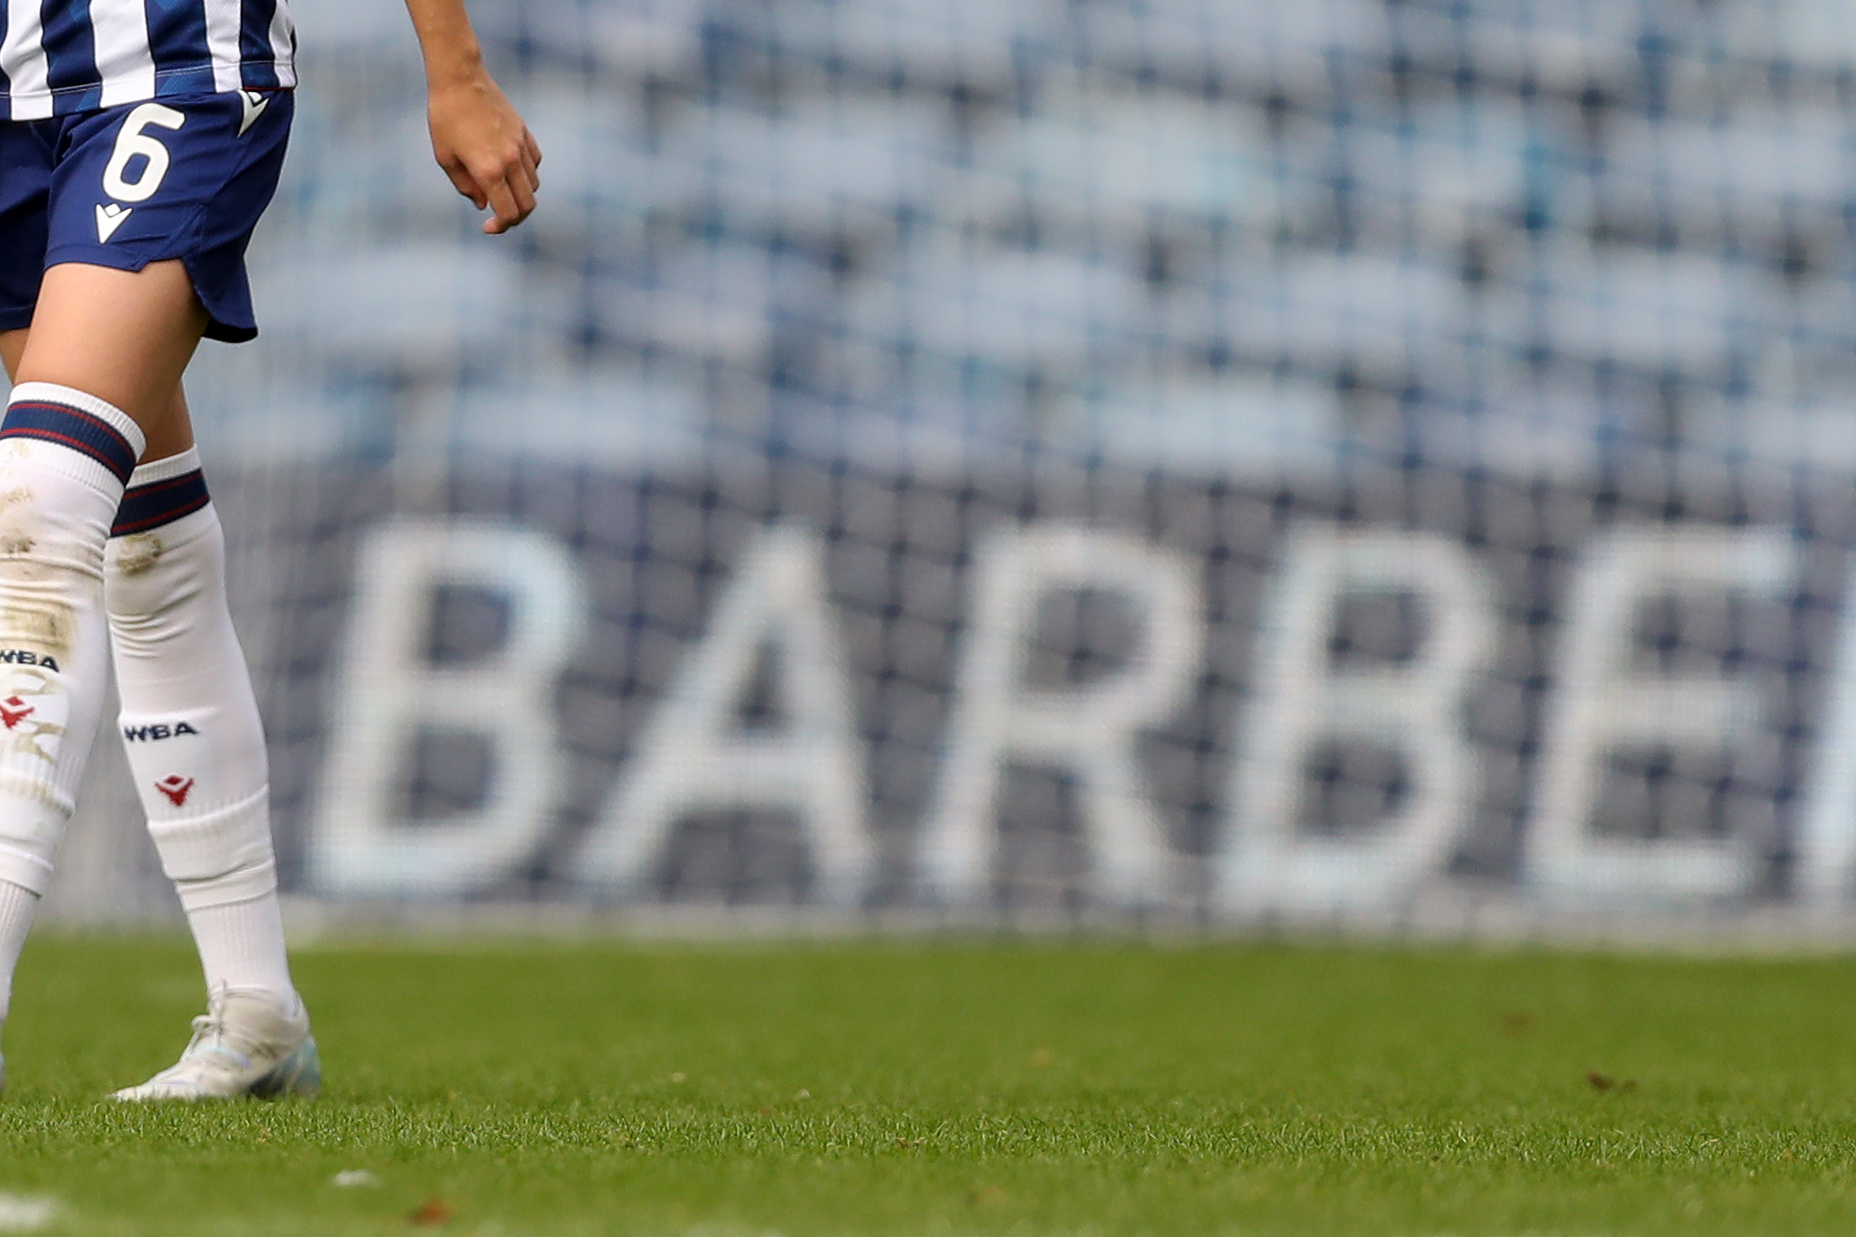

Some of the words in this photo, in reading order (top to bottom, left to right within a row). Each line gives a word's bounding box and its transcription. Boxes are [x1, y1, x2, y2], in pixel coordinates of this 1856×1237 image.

[102, 102, 186, 202] 6
[124, 720, 199, 743] WBA
[312, 517, 1856, 900] BARBE
